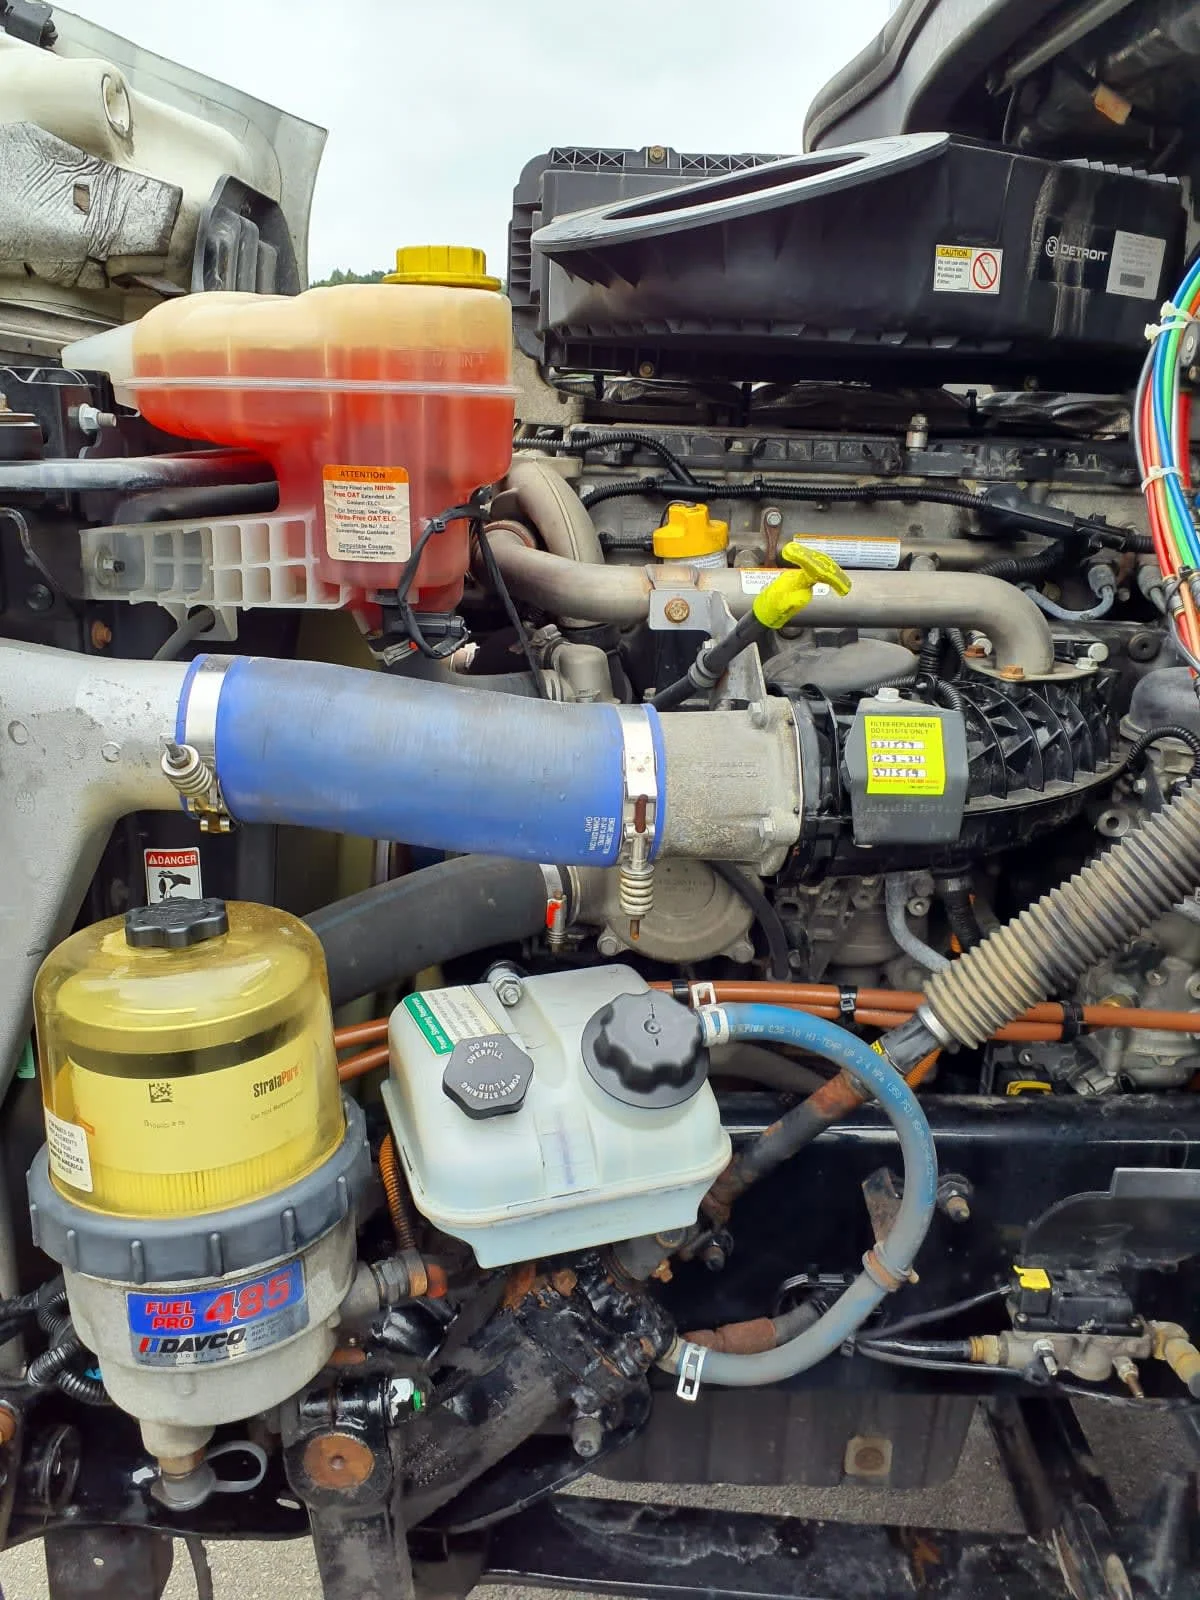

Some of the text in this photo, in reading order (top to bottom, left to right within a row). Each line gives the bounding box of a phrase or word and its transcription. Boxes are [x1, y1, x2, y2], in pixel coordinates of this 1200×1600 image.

[940, 249, 968, 257] CAUTION
[1060, 244, 1108, 261] DETROIT
[340, 471, 386, 479] ATTENTION
[158, 855, 197, 865] DANGER
[412, 997, 447, 1050] Power Steering Reservoir
[469, 1043, 480, 1052] DO
[467, 1048, 503, 1064] OVERFILL
[461, 1074, 520, 1099] POWER STEERING
[479, 1079, 506, 1091] FLUID
[62, 1158, 83, 1171] AMERICA
[205, 1271, 292, 1324] 485
[145, 1300, 195, 1316] FUEL
[152, 1316, 195, 1330] PRO
[160, 1327, 247, 1353] DAVCO
